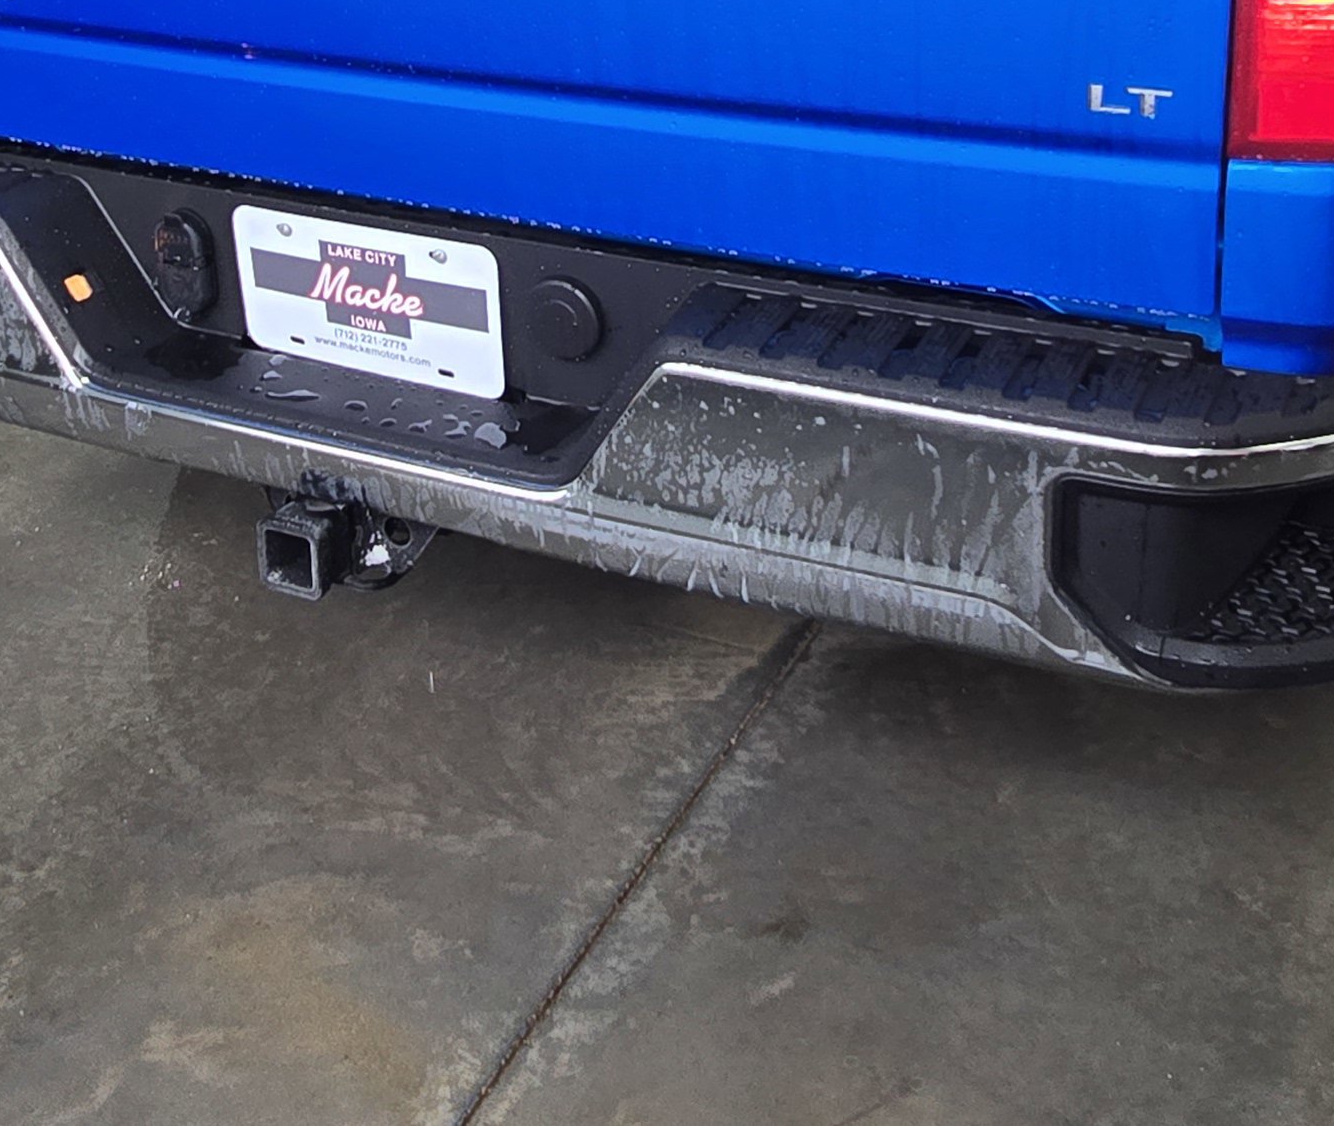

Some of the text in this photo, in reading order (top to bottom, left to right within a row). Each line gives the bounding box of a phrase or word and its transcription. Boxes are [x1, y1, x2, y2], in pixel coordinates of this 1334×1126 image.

[1088, 83, 1174, 120] LT
[327, 243, 397, 267] LAKE CITY
[309, 262, 424, 317] Macke
[334, 327, 359, 342] (712)
[350, 314, 387, 332] IOWA
[314, 336, 432, 368] www.mackemotors.com
